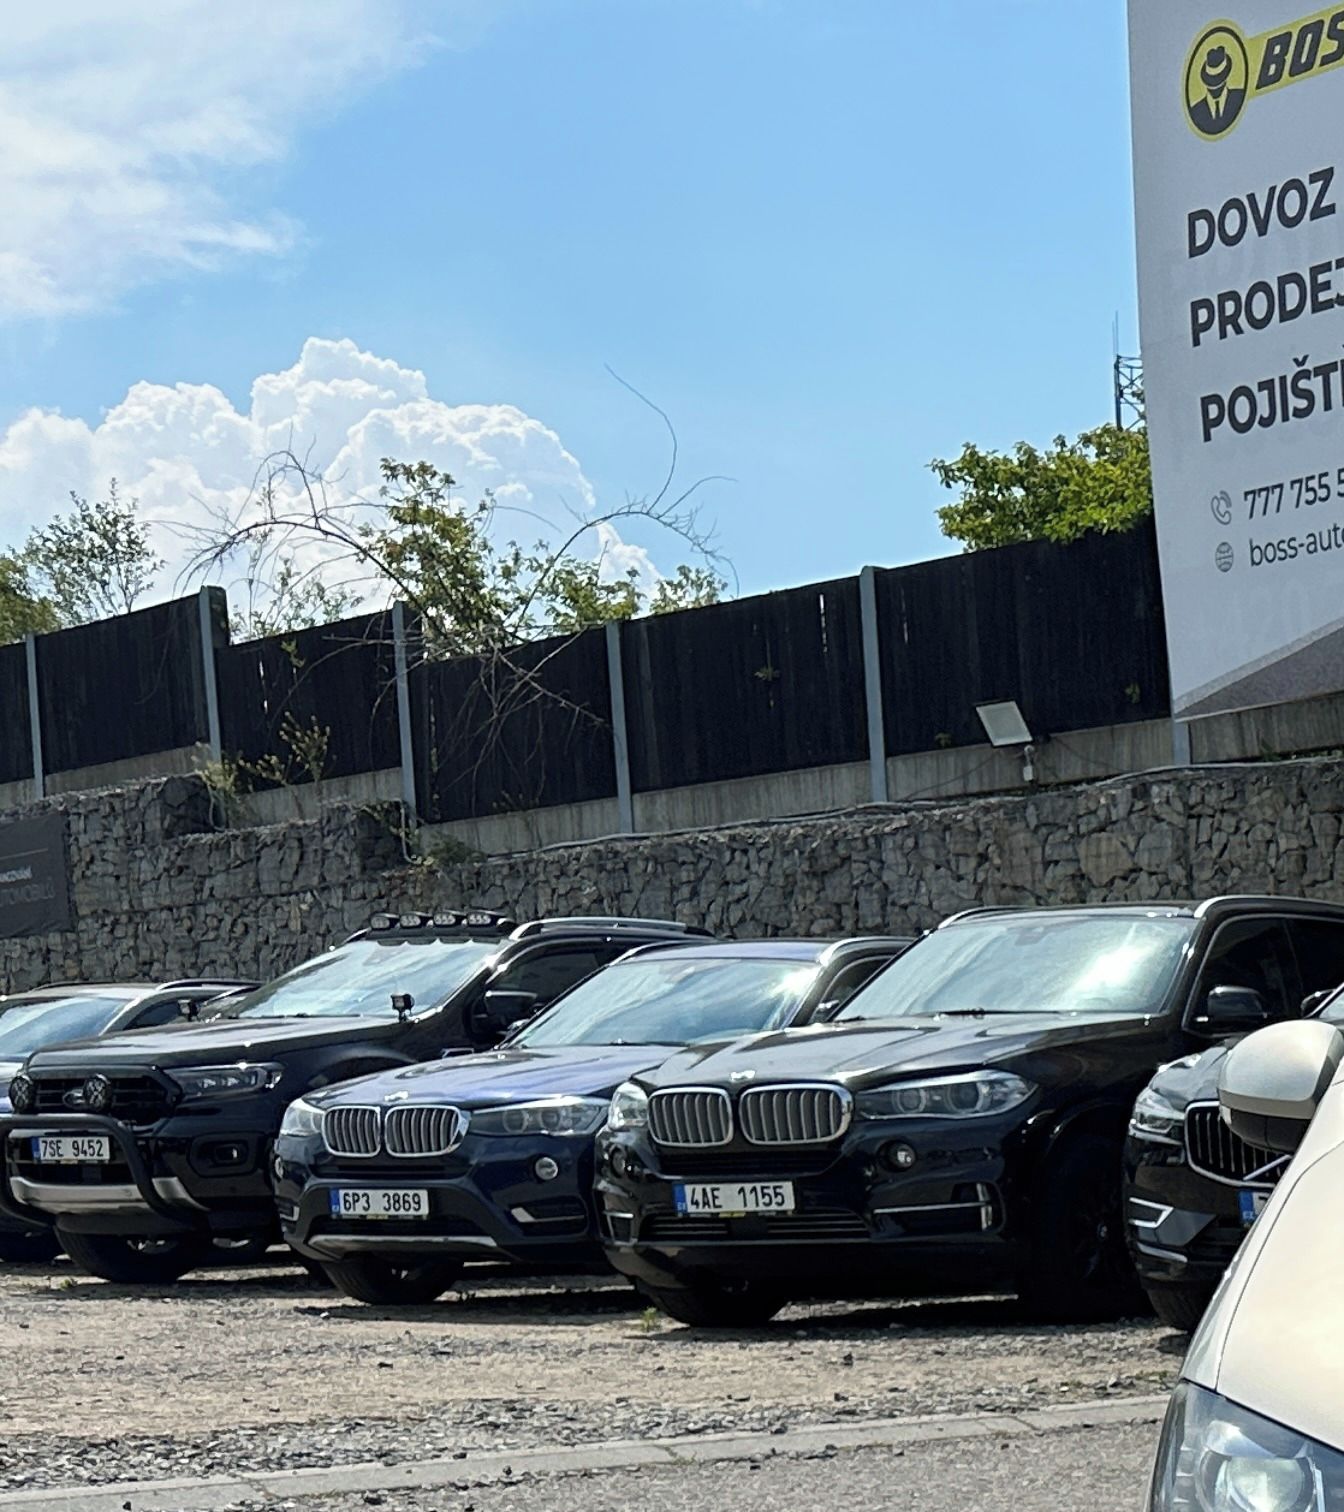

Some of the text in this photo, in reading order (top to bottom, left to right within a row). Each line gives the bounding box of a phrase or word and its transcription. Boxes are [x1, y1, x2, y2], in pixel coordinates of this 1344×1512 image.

[1187, 166, 1336, 259] DOVOZ
[1243, 482, 1284, 520] 777
[1290, 471, 1331, 509] 755
[41, 1140, 64, 1157] 7SE
[72, 1140, 104, 1157] 9452
[343, 1192, 421, 1212] 6P3 3869
[690, 1187, 722, 1209] 4AE
[738, 1185, 785, 1208] 1155
